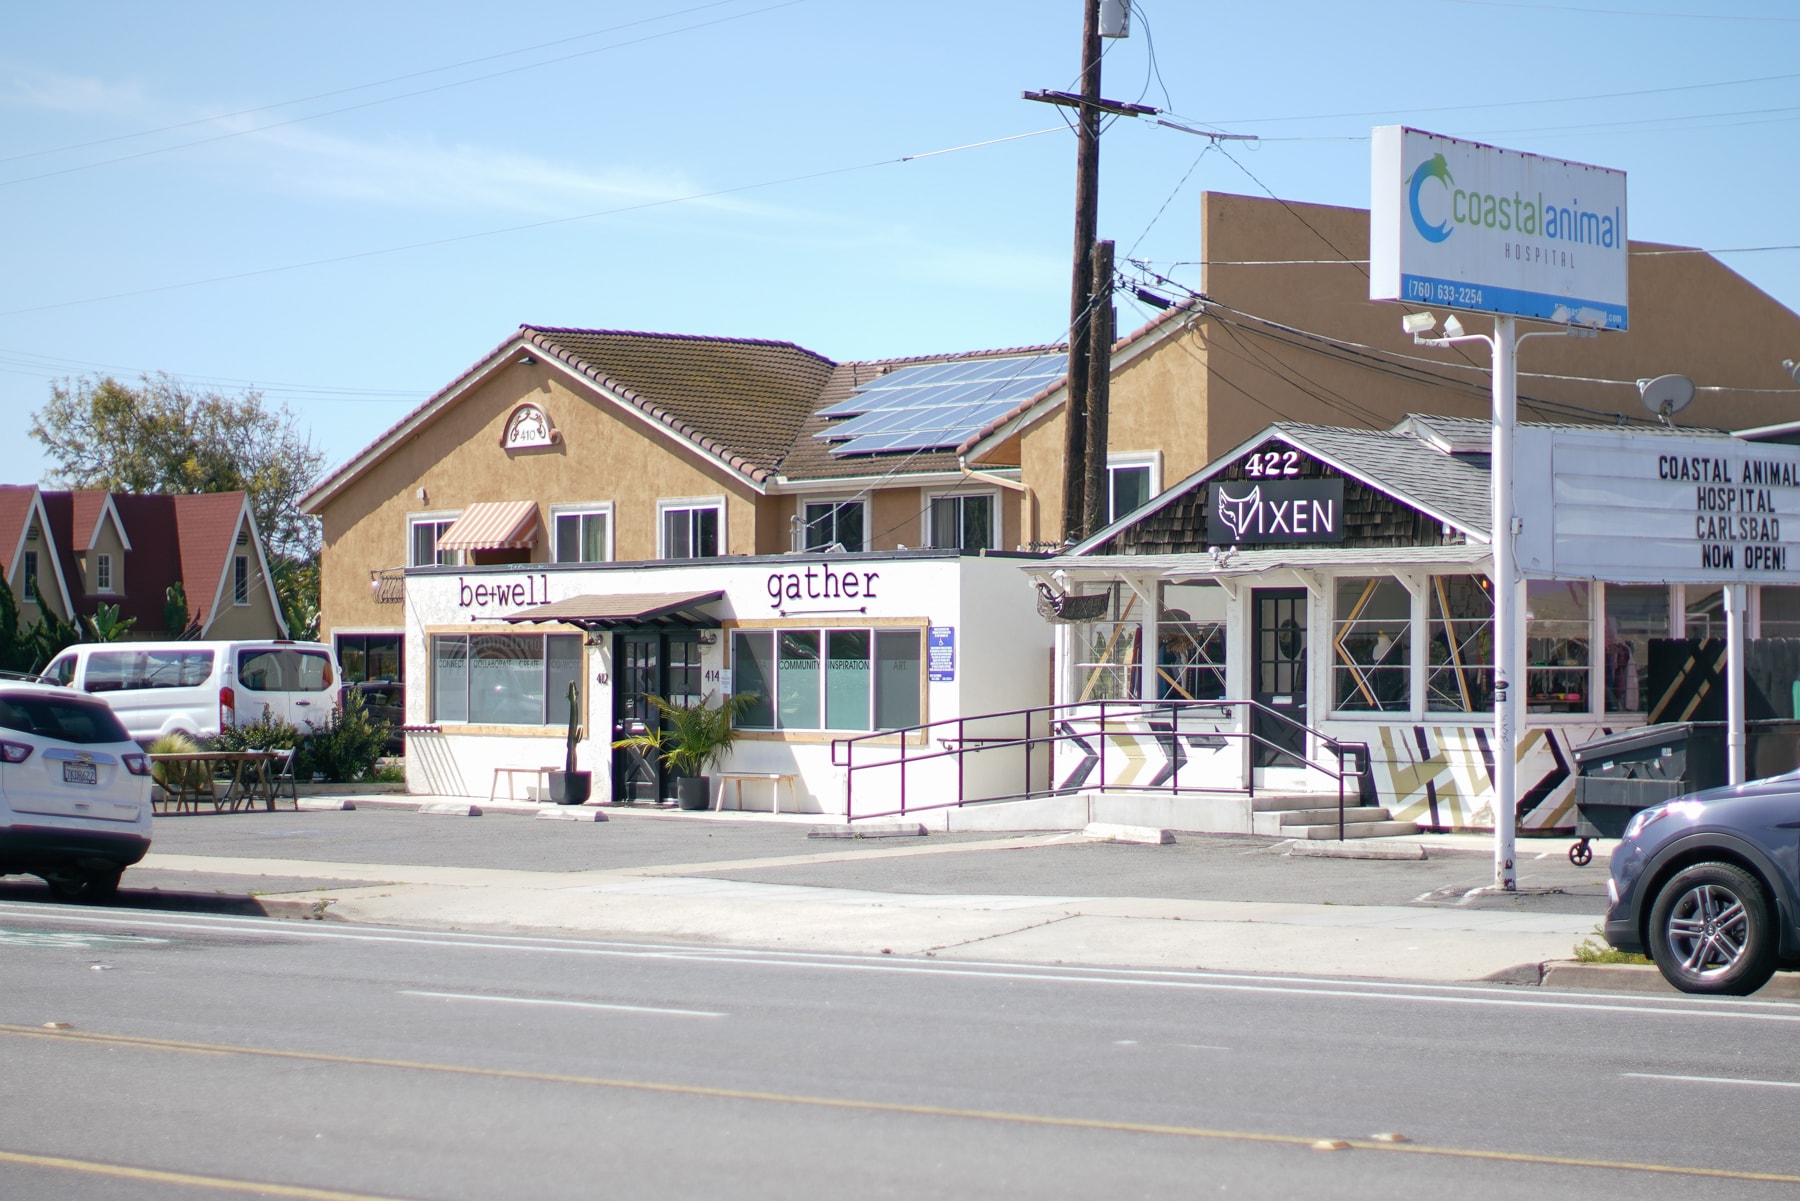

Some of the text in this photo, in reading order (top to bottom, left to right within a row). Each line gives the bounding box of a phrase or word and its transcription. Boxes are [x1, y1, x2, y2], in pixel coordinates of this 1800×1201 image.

[1505, 242, 1575, 269] HOSPITAL
[1408, 280, 1482, 304] (760) 633-2254
[520, 429, 535, 441] 410
[1245, 451, 1299, 476] 422
[1659, 455, 1800, 487] COASTAL ANIMAL
[1697, 486, 1776, 513] HOSPITAL
[1236, 493, 1333, 537] VIXEN
[1696, 515, 1780, 541] CARLSBAD
[1702, 543, 1786, 570] NOW OPEN!
[459, 574, 551, 607] be+well
[767, 563, 880, 608] gather
[705, 670, 720, 683] 414
